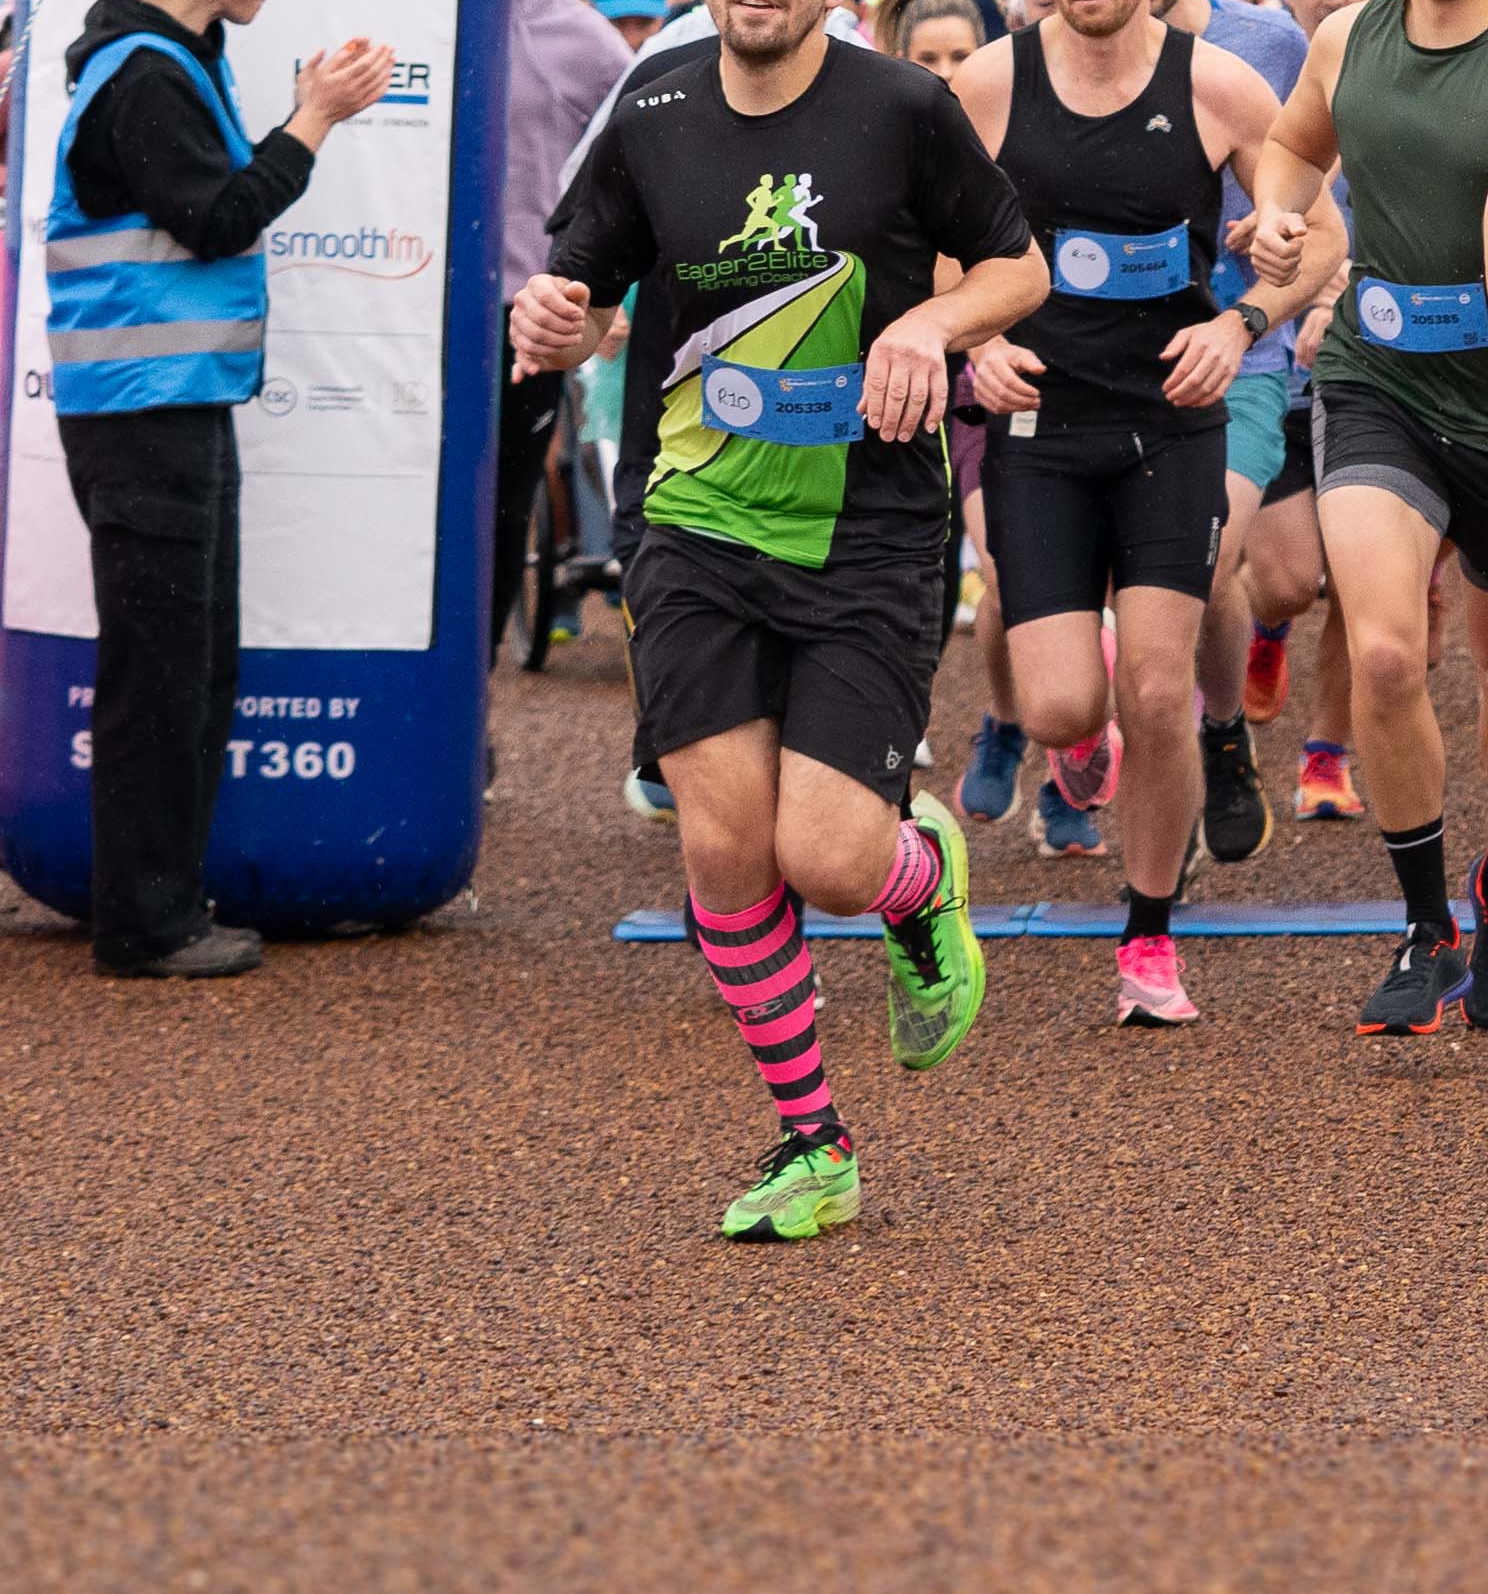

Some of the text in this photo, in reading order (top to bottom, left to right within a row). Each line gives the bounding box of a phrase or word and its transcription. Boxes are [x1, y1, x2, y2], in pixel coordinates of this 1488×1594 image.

[675, 251, 829, 282] Eager2Elite
[698, 274, 758, 291] Running
[776, 402, 832, 414] 205338
[329, 698, 361, 719] BY
